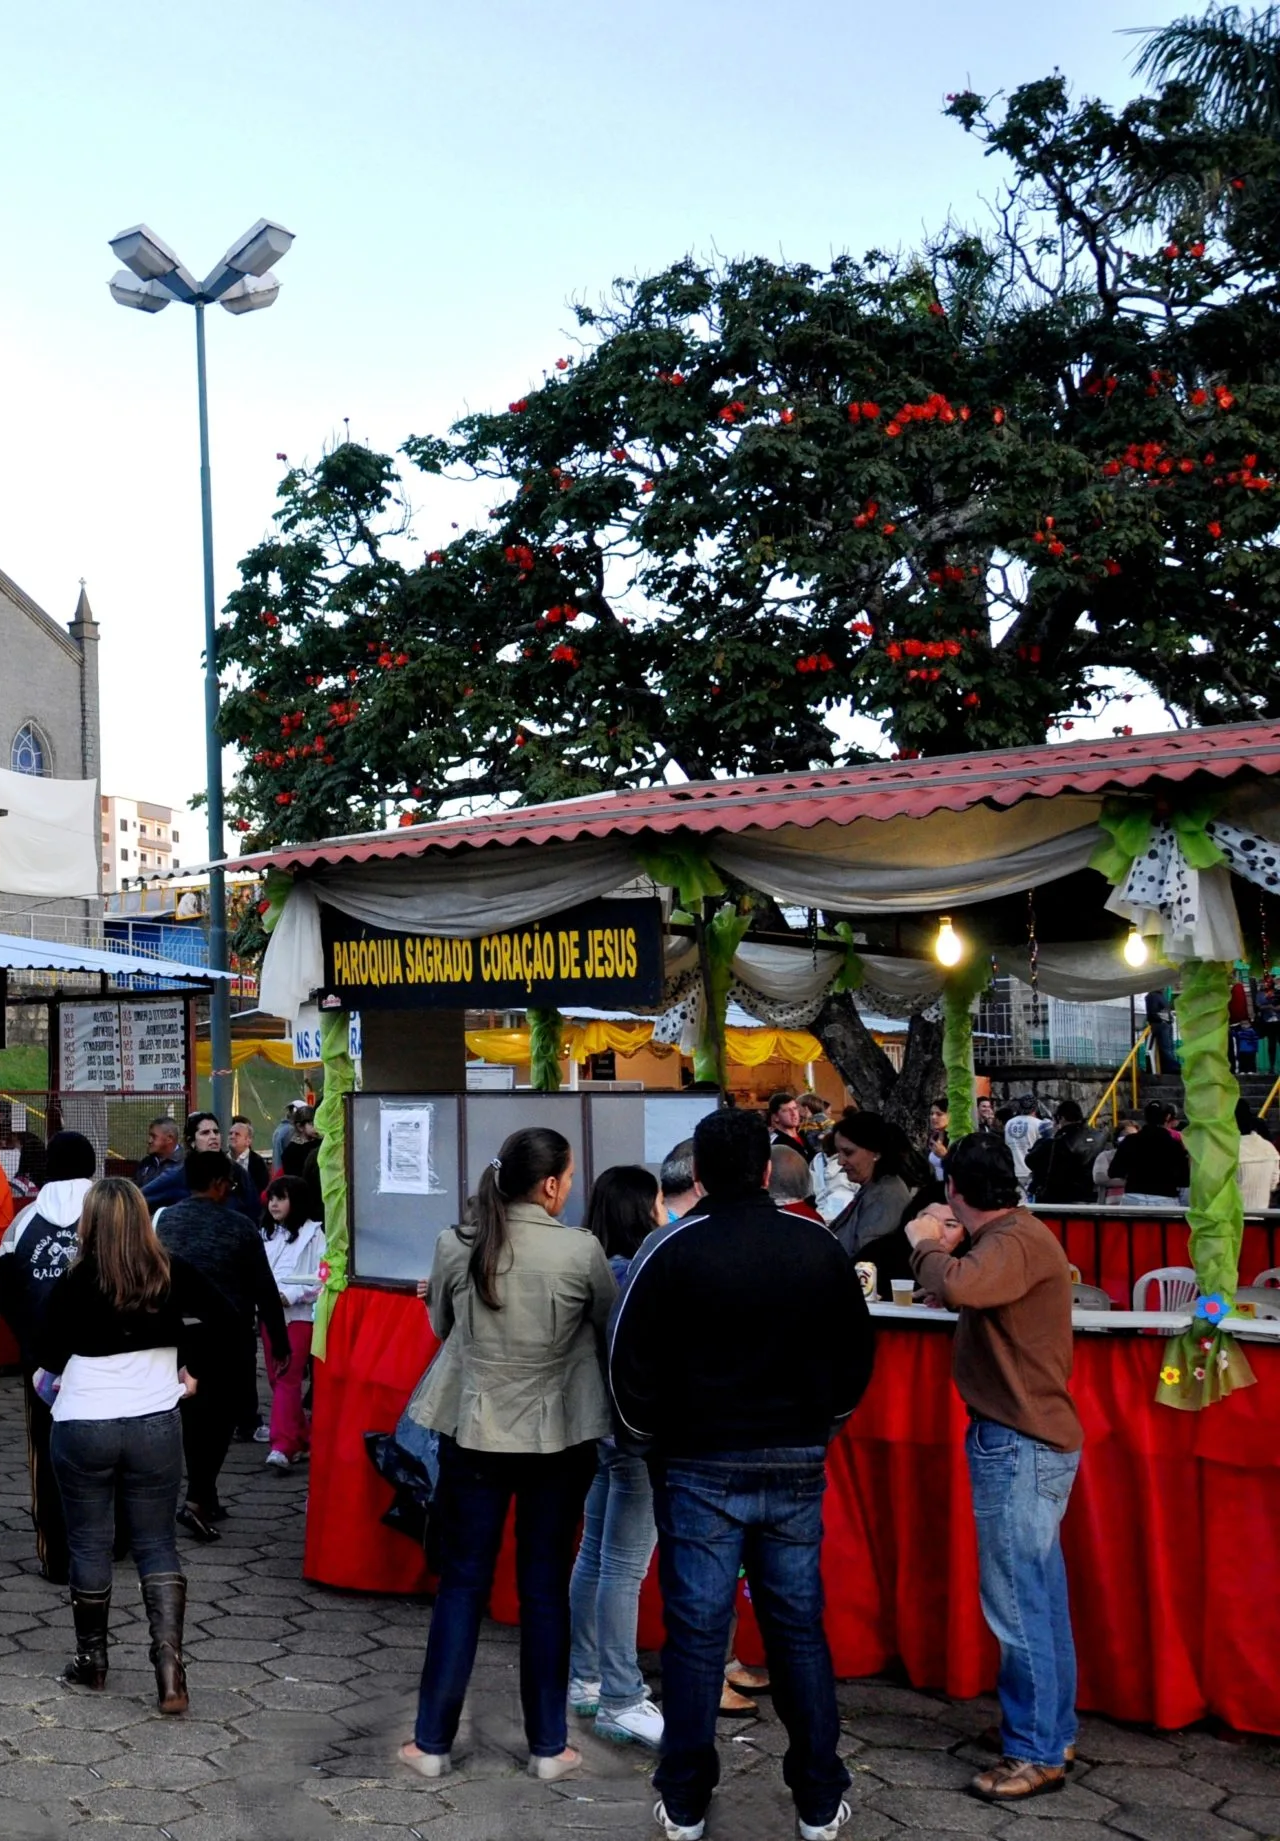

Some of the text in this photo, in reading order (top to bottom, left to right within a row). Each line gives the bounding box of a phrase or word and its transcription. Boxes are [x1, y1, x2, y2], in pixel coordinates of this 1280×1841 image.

[333, 923, 638, 993] PARÓQUIA SAGRADO CORAÇÃO DE JESUS
[30, 1236, 52, 1263] TORCIDA
